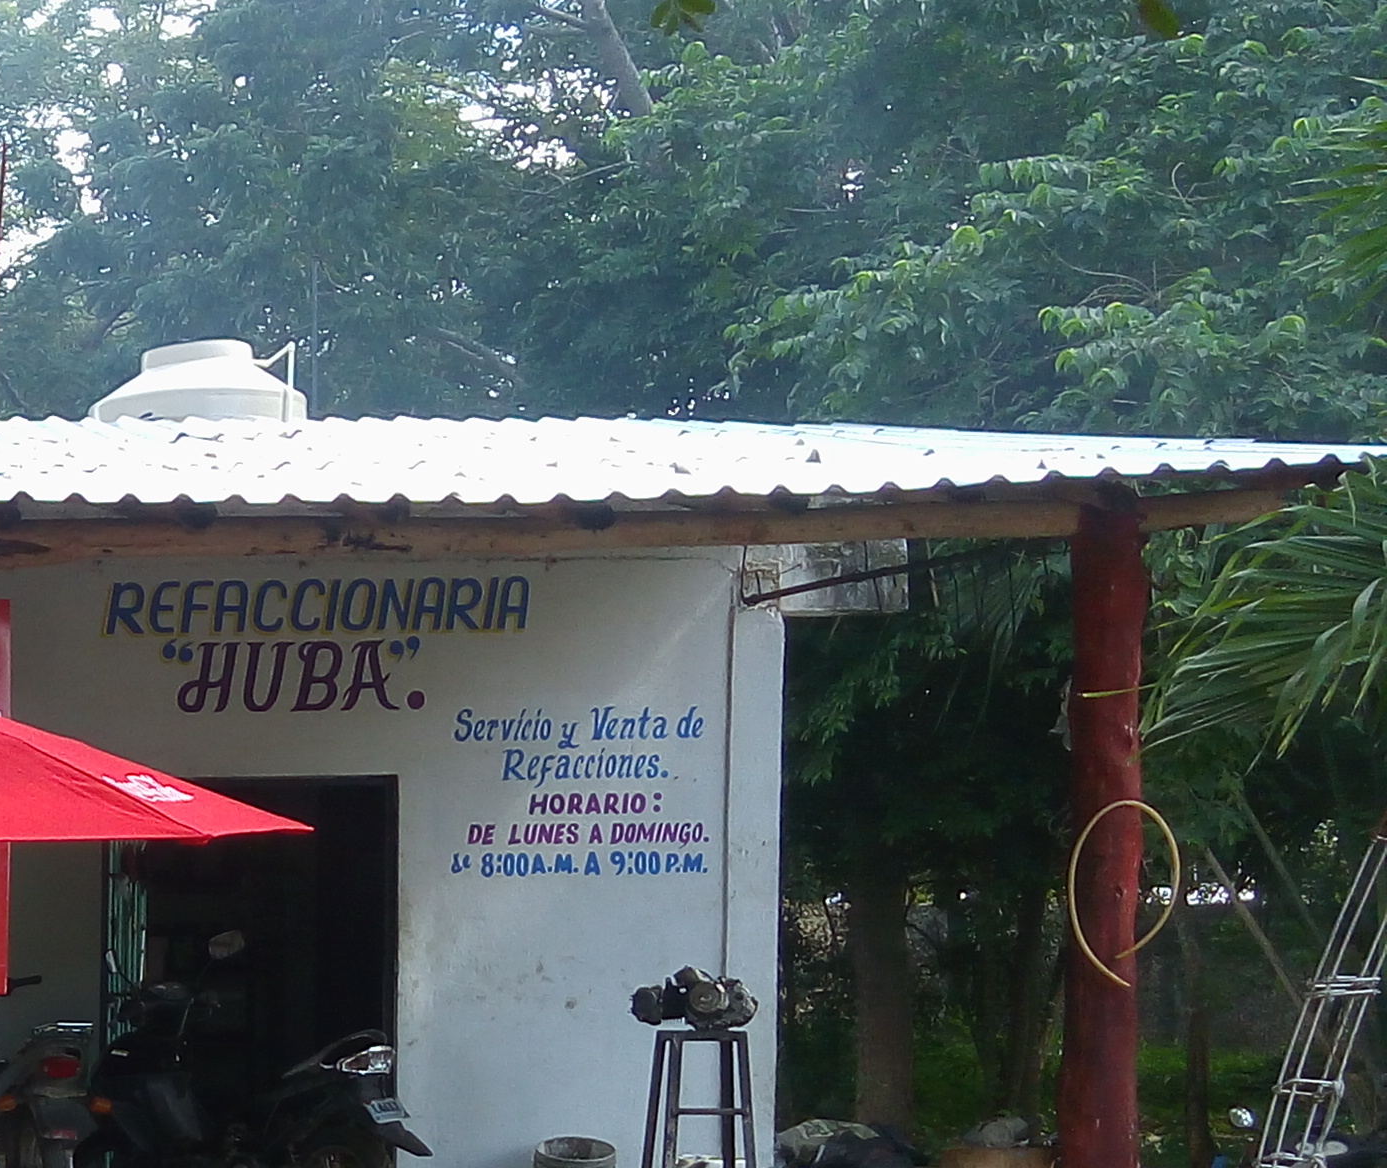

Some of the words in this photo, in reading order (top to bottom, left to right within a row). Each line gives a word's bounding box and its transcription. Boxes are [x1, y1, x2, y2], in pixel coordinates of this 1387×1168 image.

[104, 575, 528, 635] REFACCIONARIA
[454, 708, 552, 742] Servicio
[558, 721, 580, 749] y
[590, 706, 669, 741] Venta
[677, 706, 704, 739] de
[468, 824, 496, 845] DE
[508, 823, 579, 845] LUNES
[589, 823, 603, 844] A
[584, 851, 600, 875] A
